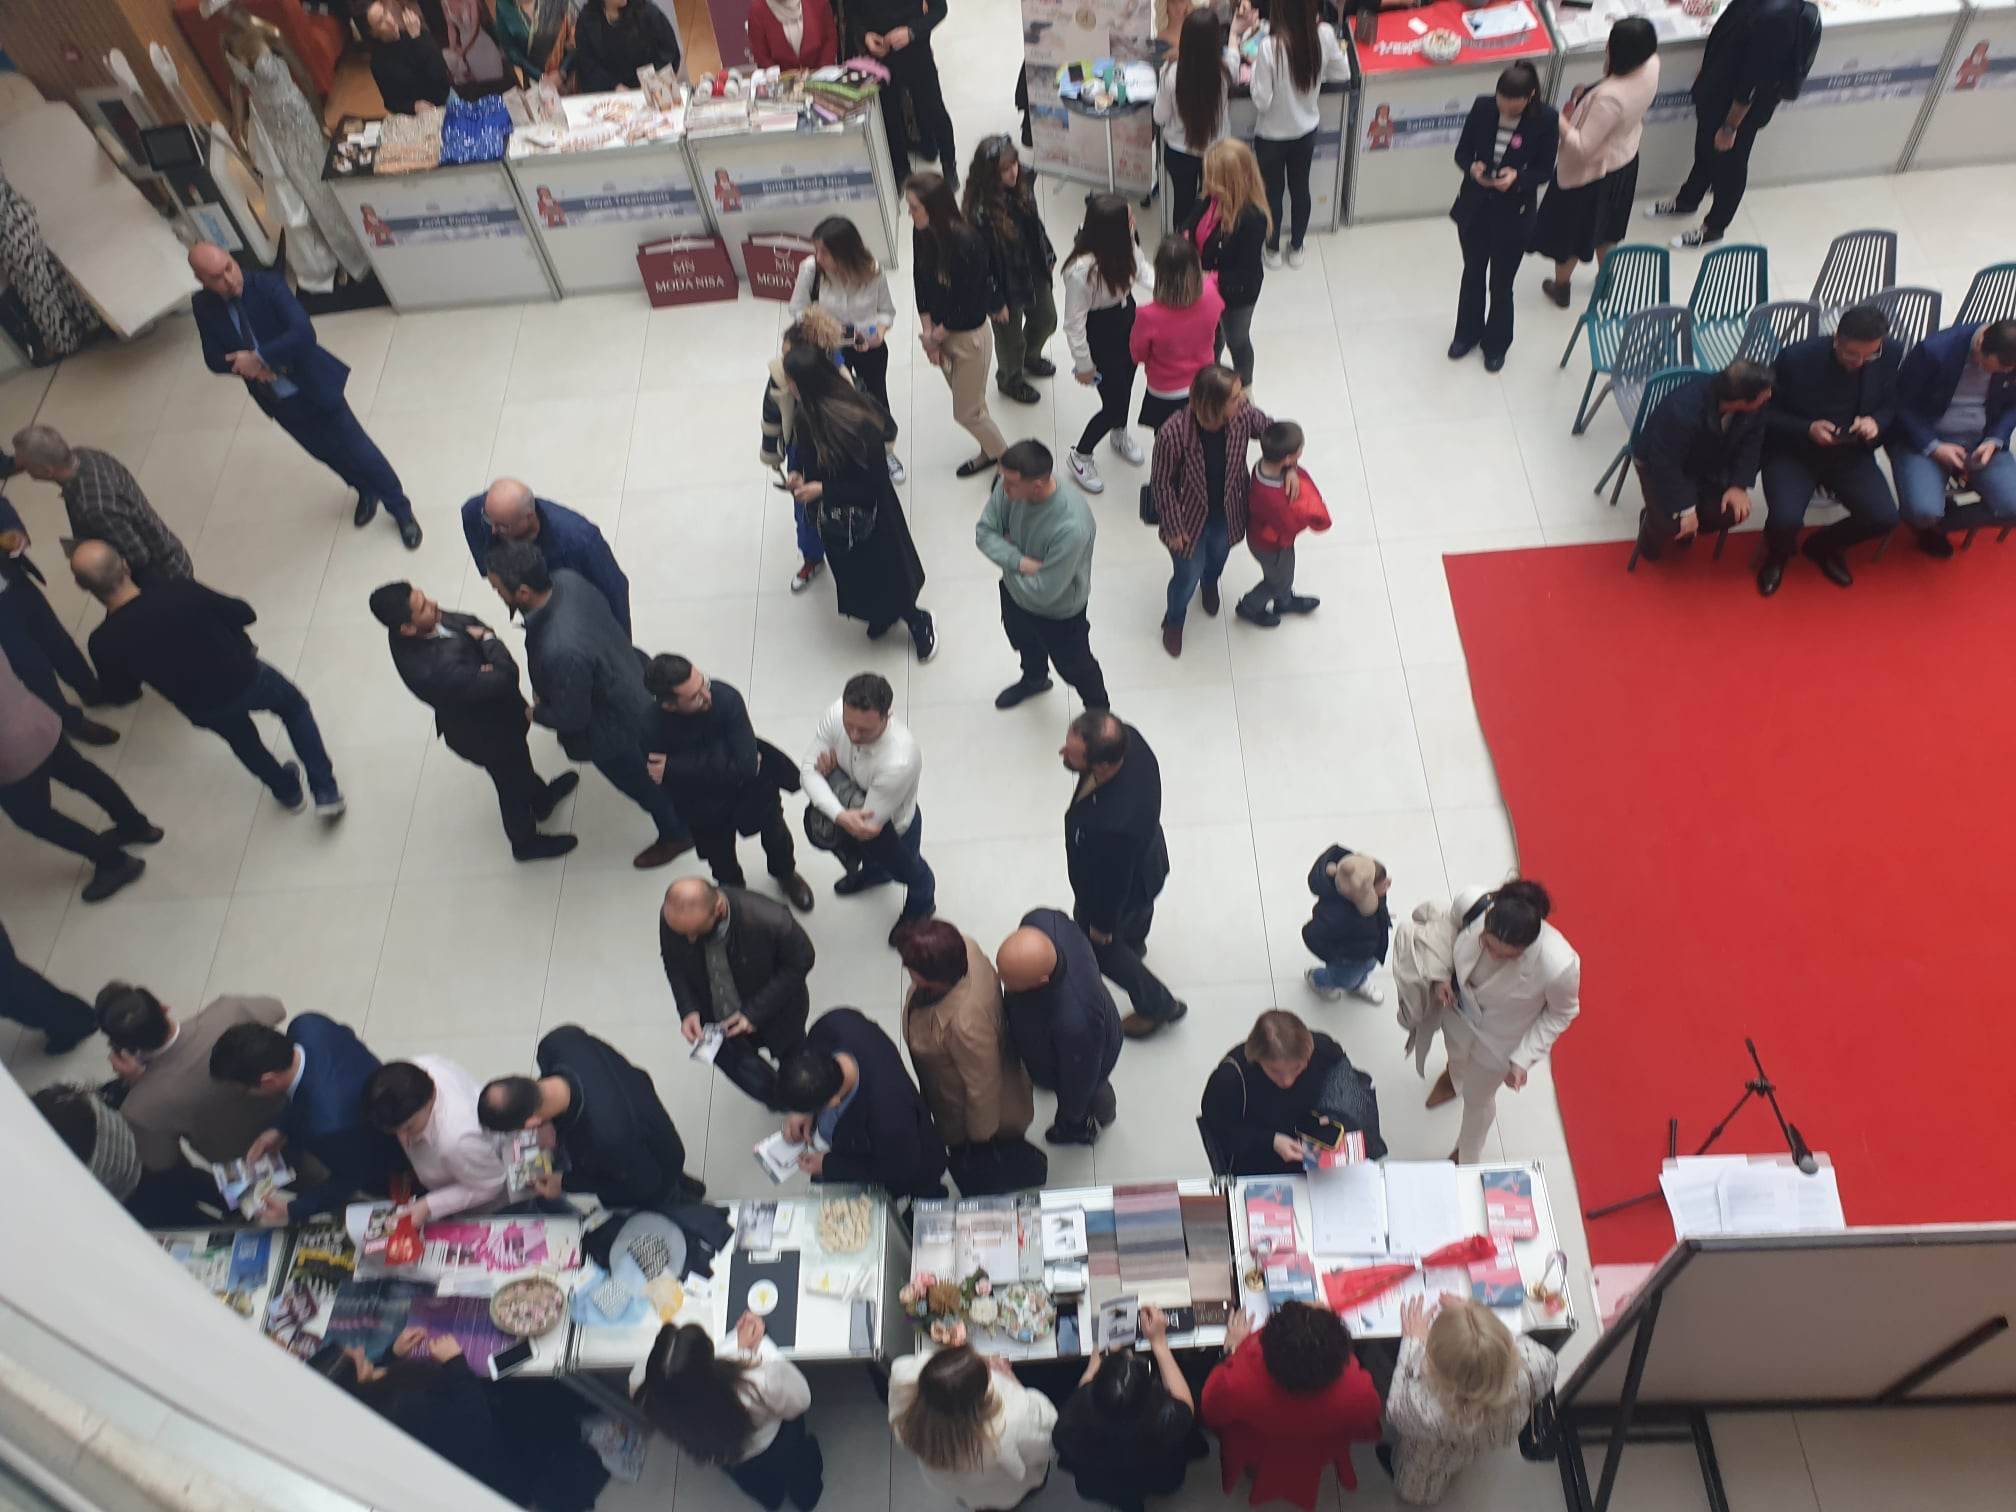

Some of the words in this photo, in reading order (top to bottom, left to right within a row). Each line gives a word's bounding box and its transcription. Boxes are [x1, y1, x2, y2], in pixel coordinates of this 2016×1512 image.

[672, 258, 696, 275] MN
[775, 257, 795, 273] MN
[655, 278, 694, 294] MODA
[695, 274, 725, 290] NISA
[756, 271, 793, 289] MODA
